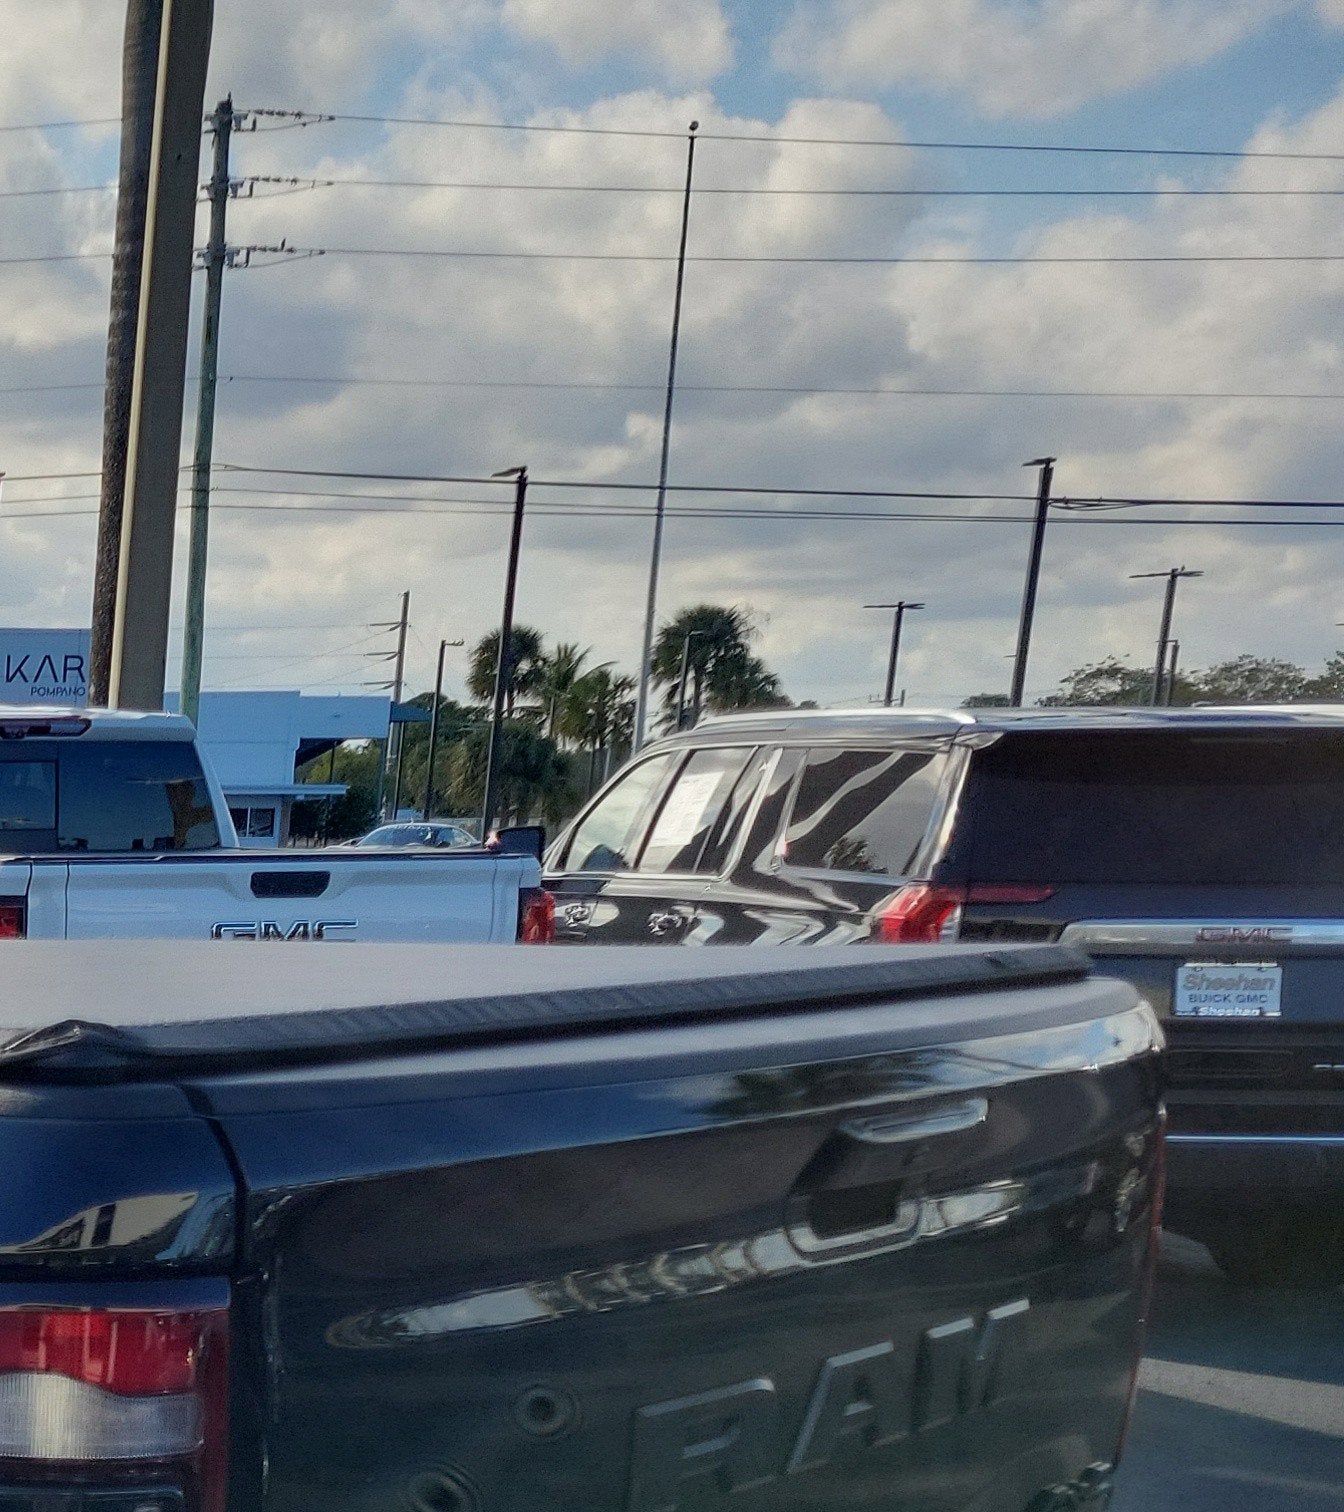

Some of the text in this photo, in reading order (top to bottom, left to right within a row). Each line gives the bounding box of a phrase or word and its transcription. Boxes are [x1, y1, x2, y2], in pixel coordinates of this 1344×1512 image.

[30, 686, 86, 696] POMPANO
[211, 919, 359, 941] GMC
[1196, 926, 1293, 942] GMC
[1182, 973, 1275, 991] Sheehan
[1188, 993, 1268, 1004] BUICK GMC
